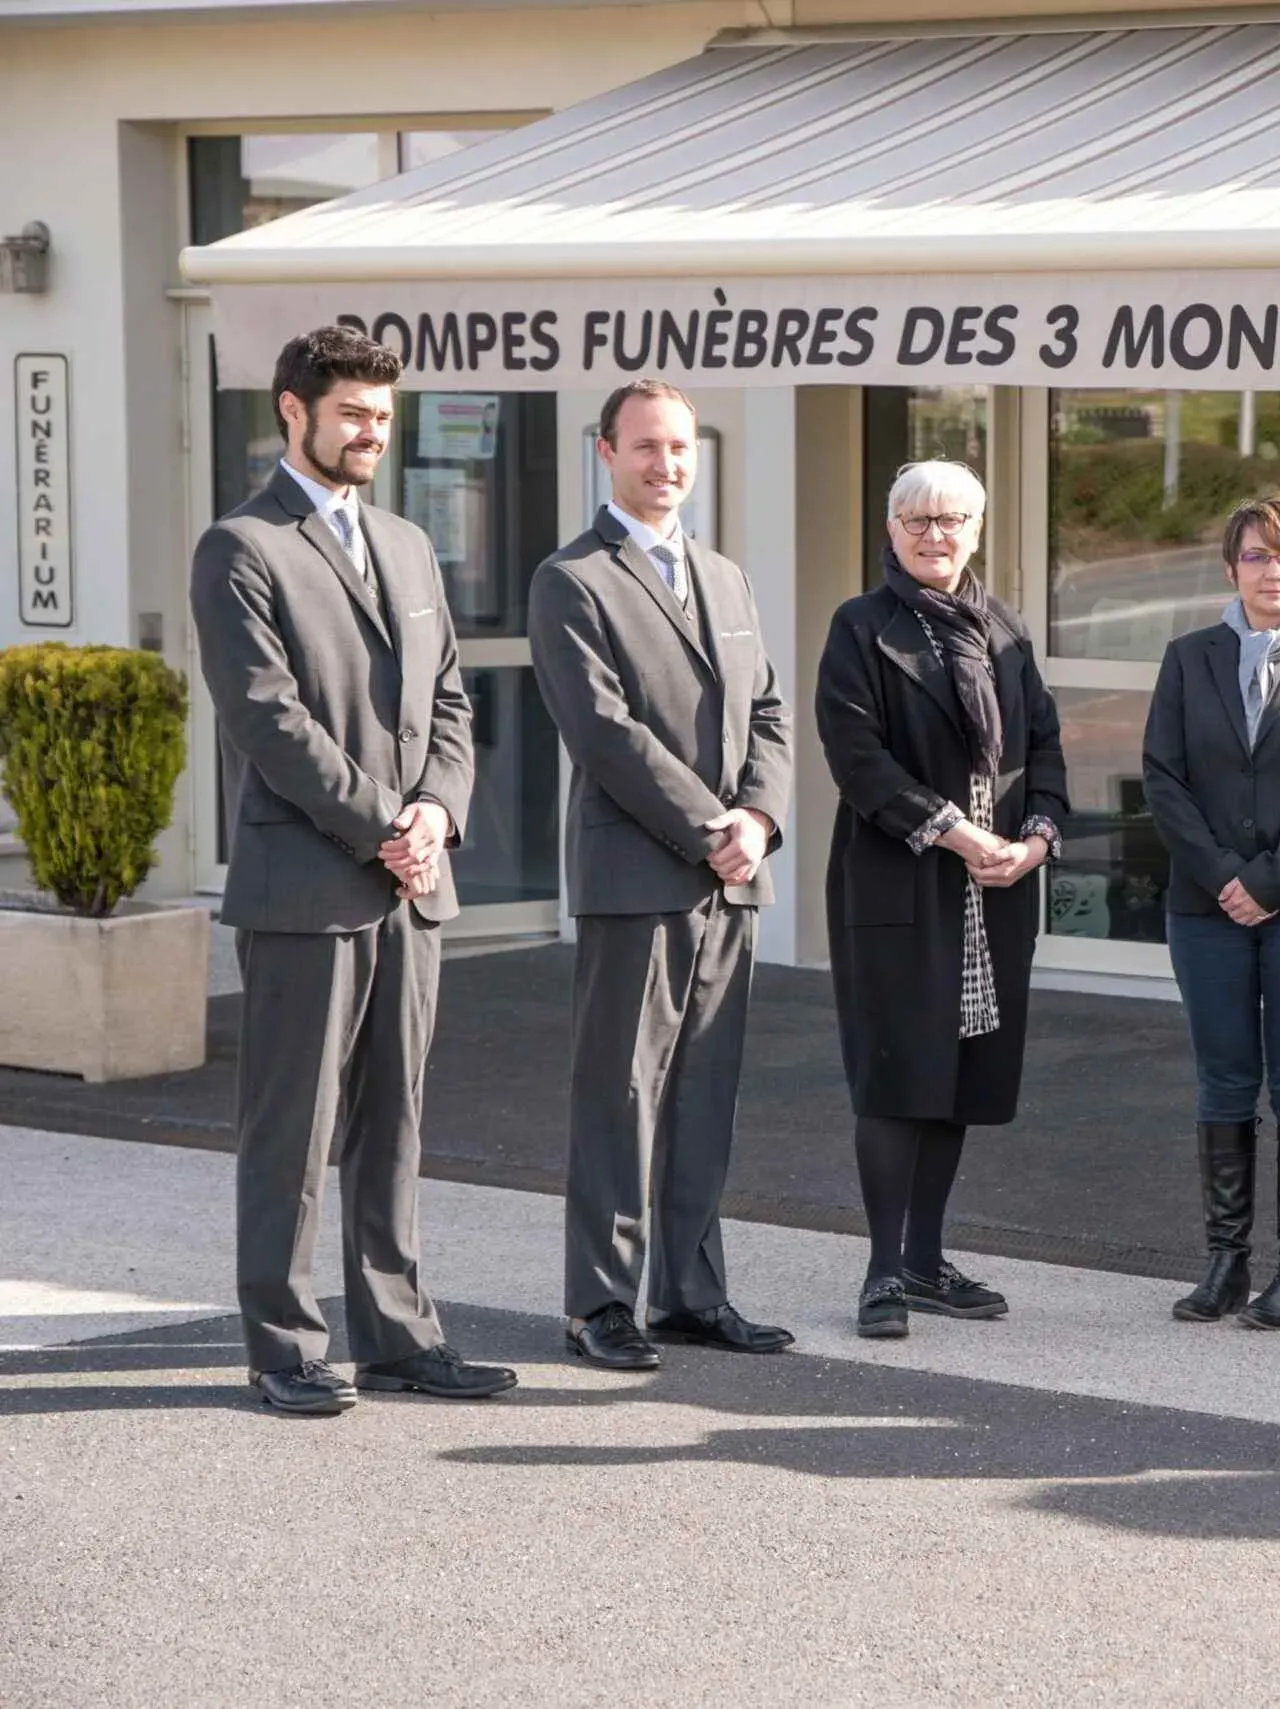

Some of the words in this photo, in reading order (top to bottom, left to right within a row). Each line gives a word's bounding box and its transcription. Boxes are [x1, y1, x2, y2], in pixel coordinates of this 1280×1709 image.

[581, 286, 879, 372] FUNÈBRES
[895, 305, 1019, 367] DES
[1038, 304, 1080, 370] 3
